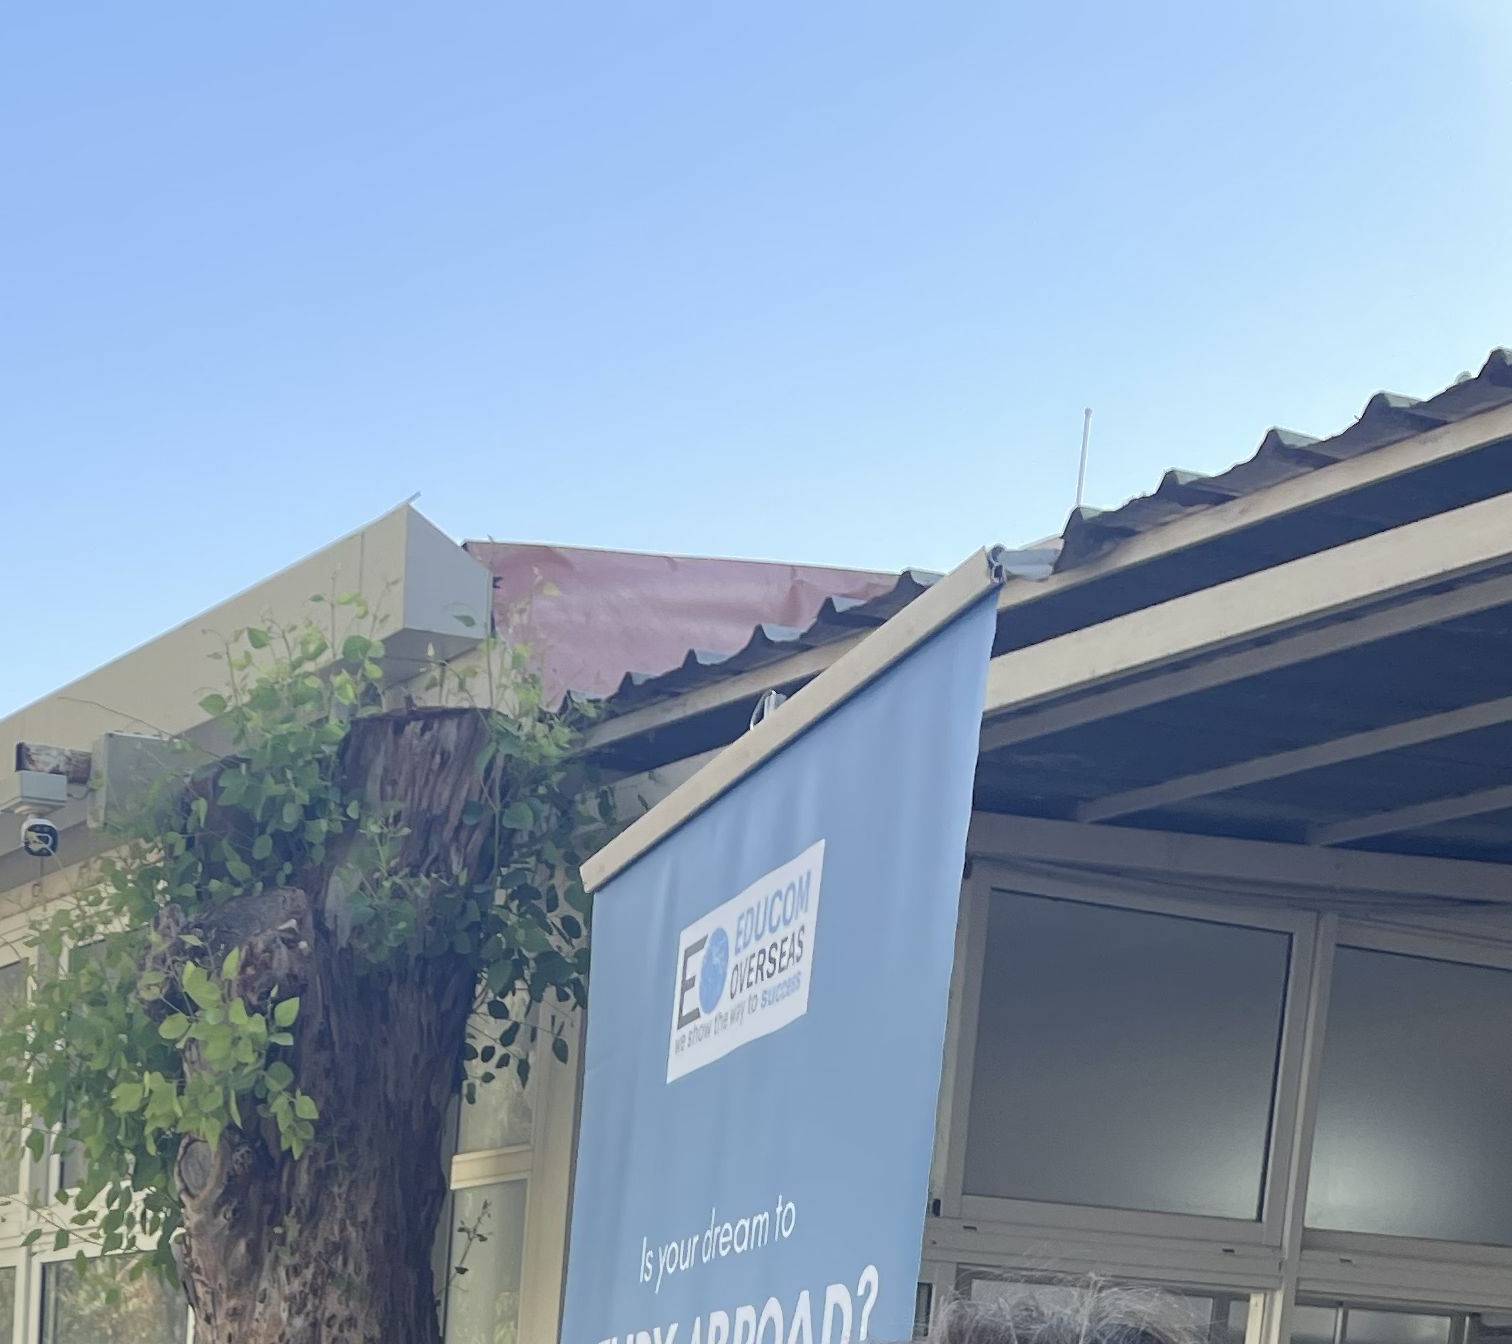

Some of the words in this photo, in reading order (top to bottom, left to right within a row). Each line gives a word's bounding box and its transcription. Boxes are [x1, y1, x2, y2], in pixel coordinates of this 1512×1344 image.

[735, 871, 812, 954] EDUCOM
[730, 925, 805, 999] OVERSEAS
[688, 1021, 711, 1047] show
[747, 991, 758, 1014] to
[640, 1236, 653, 1283] Is
[655, 1234, 699, 1294] your
[702, 1207, 769, 1264] dream
[774, 1194, 796, 1241] to
